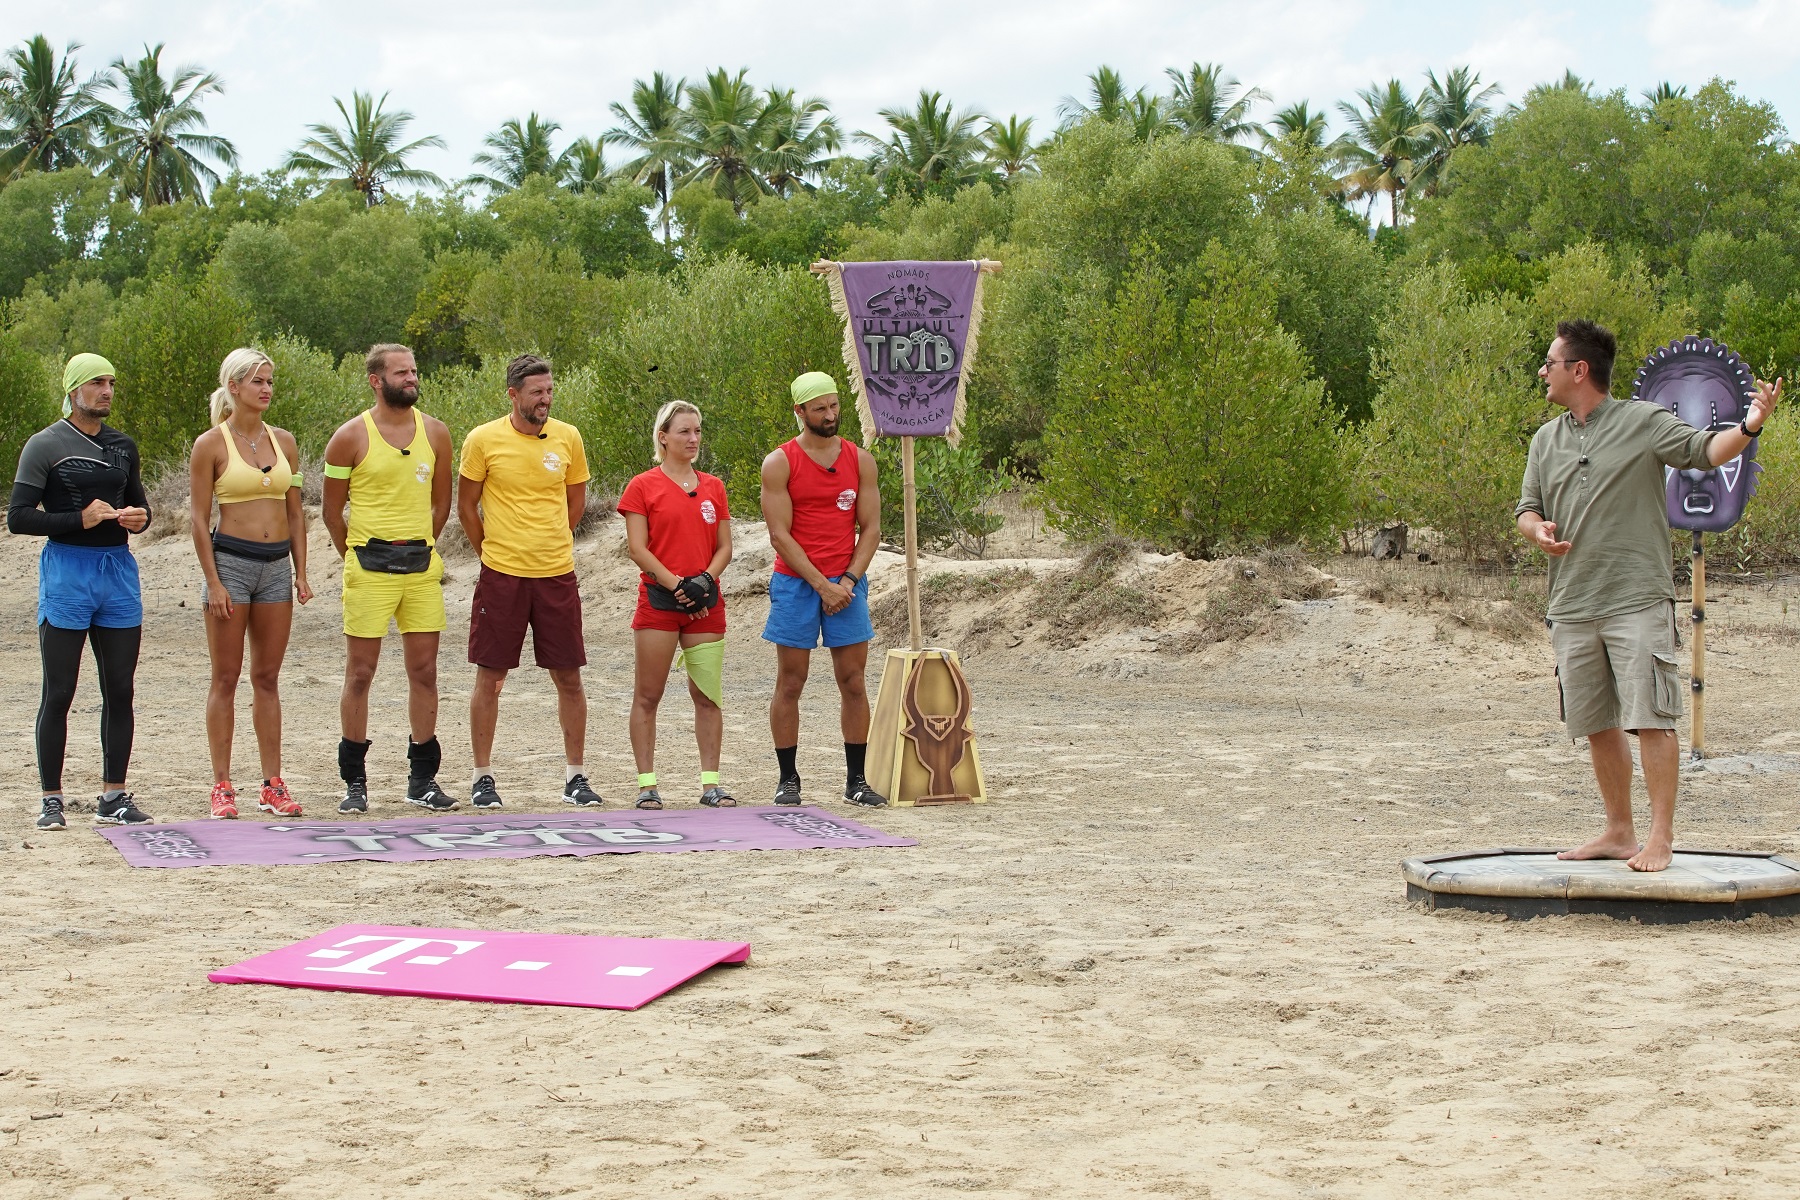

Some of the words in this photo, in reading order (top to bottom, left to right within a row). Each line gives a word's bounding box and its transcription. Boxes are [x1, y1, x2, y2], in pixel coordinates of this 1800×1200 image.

[887, 269, 930, 280] NOMADS
[863, 319, 955, 333] ULTIMUL
[863, 328, 955, 372] TRIB
[880, 407, 946, 427] MADAGASCAR
[315, 828, 684, 851] TRIB
[303, 934, 487, 976] T
